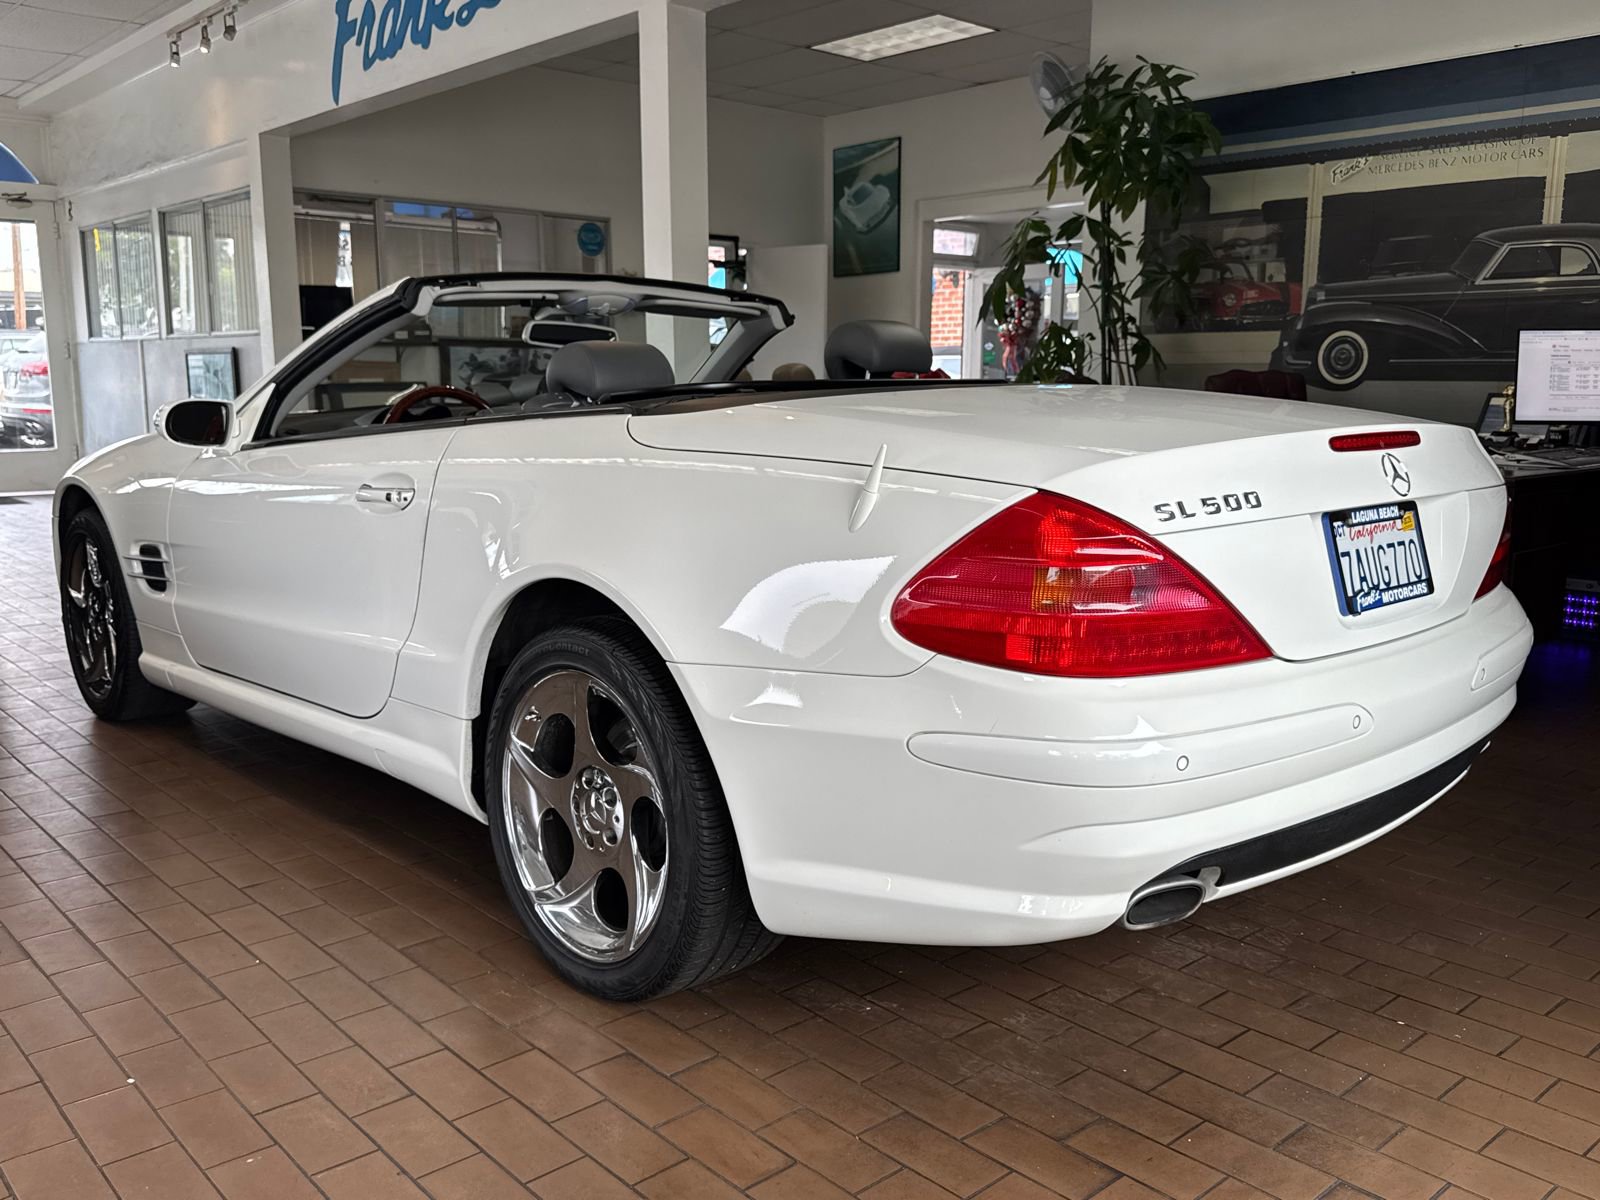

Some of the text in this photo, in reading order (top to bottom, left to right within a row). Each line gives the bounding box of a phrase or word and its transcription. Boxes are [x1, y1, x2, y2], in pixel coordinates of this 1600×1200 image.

[1367, 146, 1545, 176] MERCEDES BENZ MOTOR CARS
[1351, 505, 1399, 524] LAGUNA BEACH
[1349, 520, 1404, 544] California
[1340, 539, 1423, 592] 7AUG770
[1382, 582, 1428, 604] MOTORCARS
